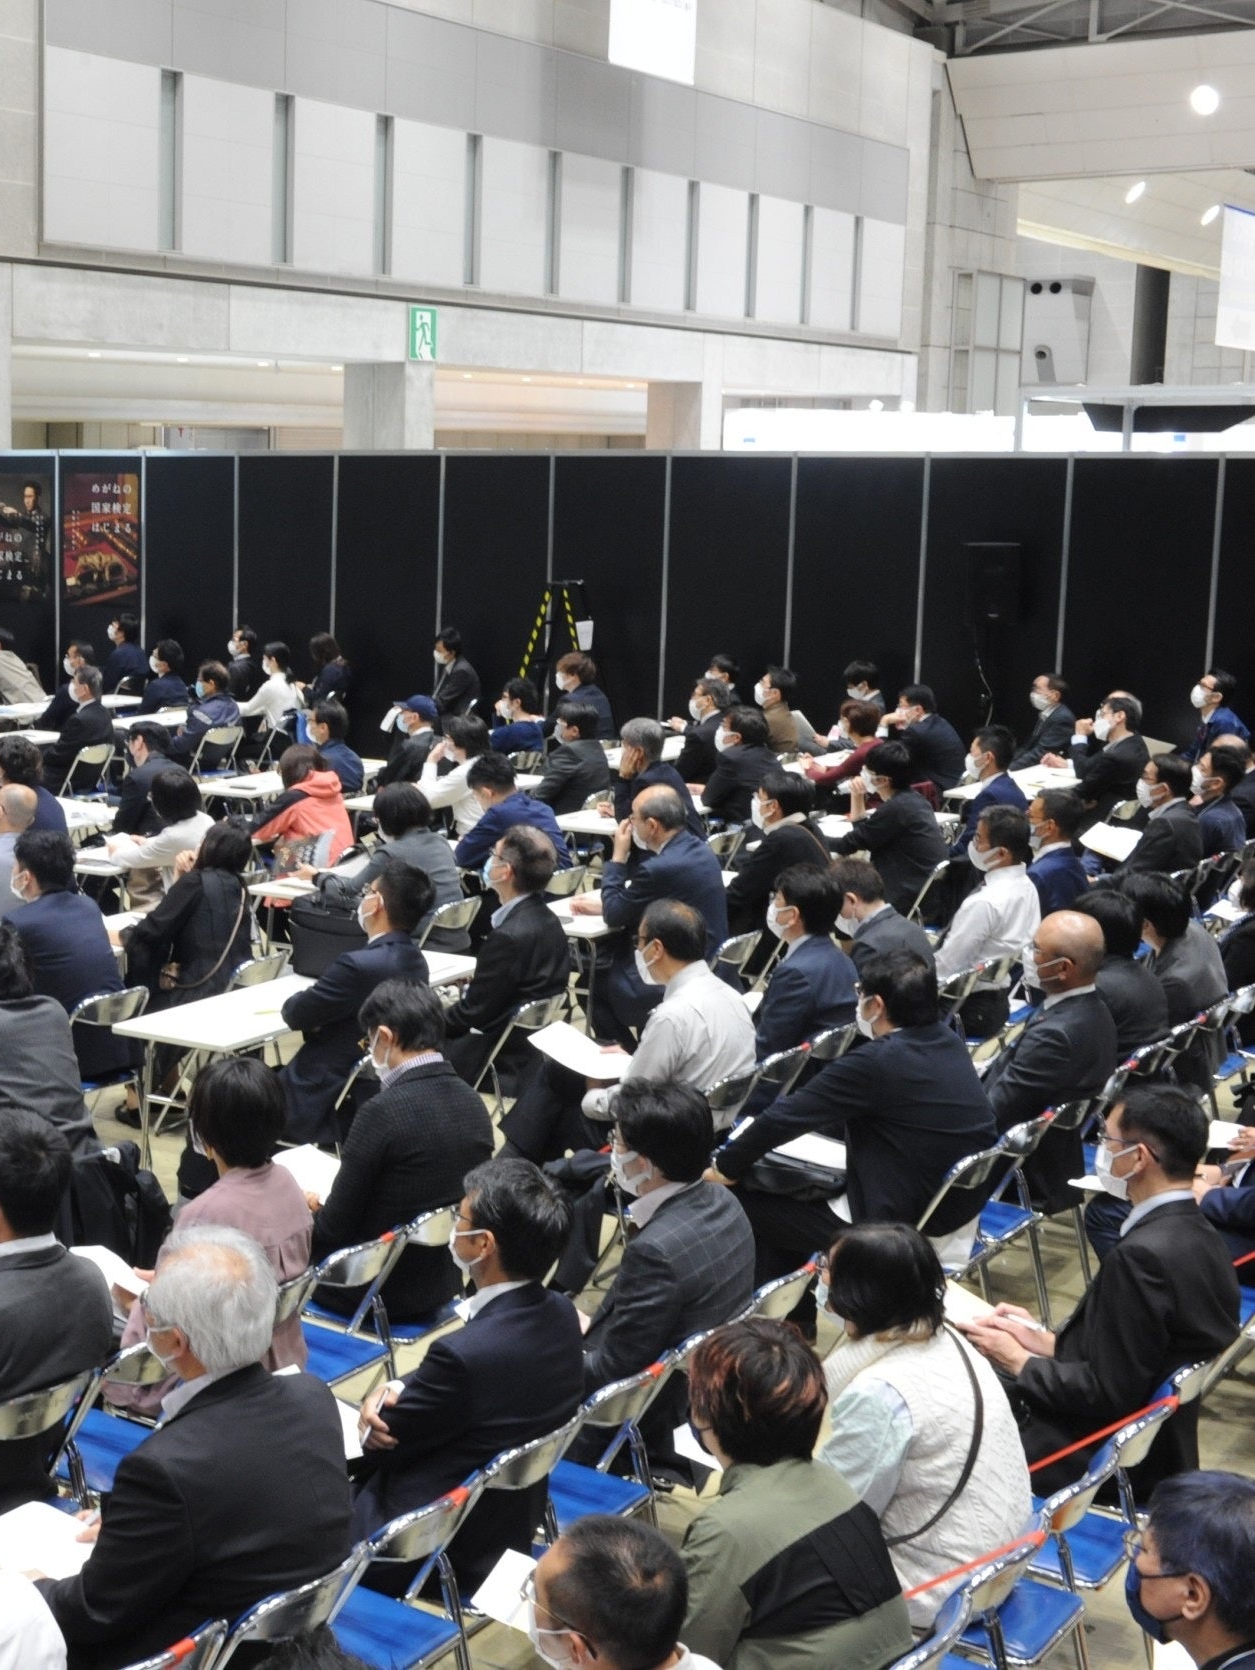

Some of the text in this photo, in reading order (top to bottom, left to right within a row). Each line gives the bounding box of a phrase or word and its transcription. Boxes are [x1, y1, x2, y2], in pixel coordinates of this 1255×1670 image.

[91, 483, 132, 494] めがねの
[91, 502, 132, 514] 国家検定
[91, 522, 132, 533] はじまる
